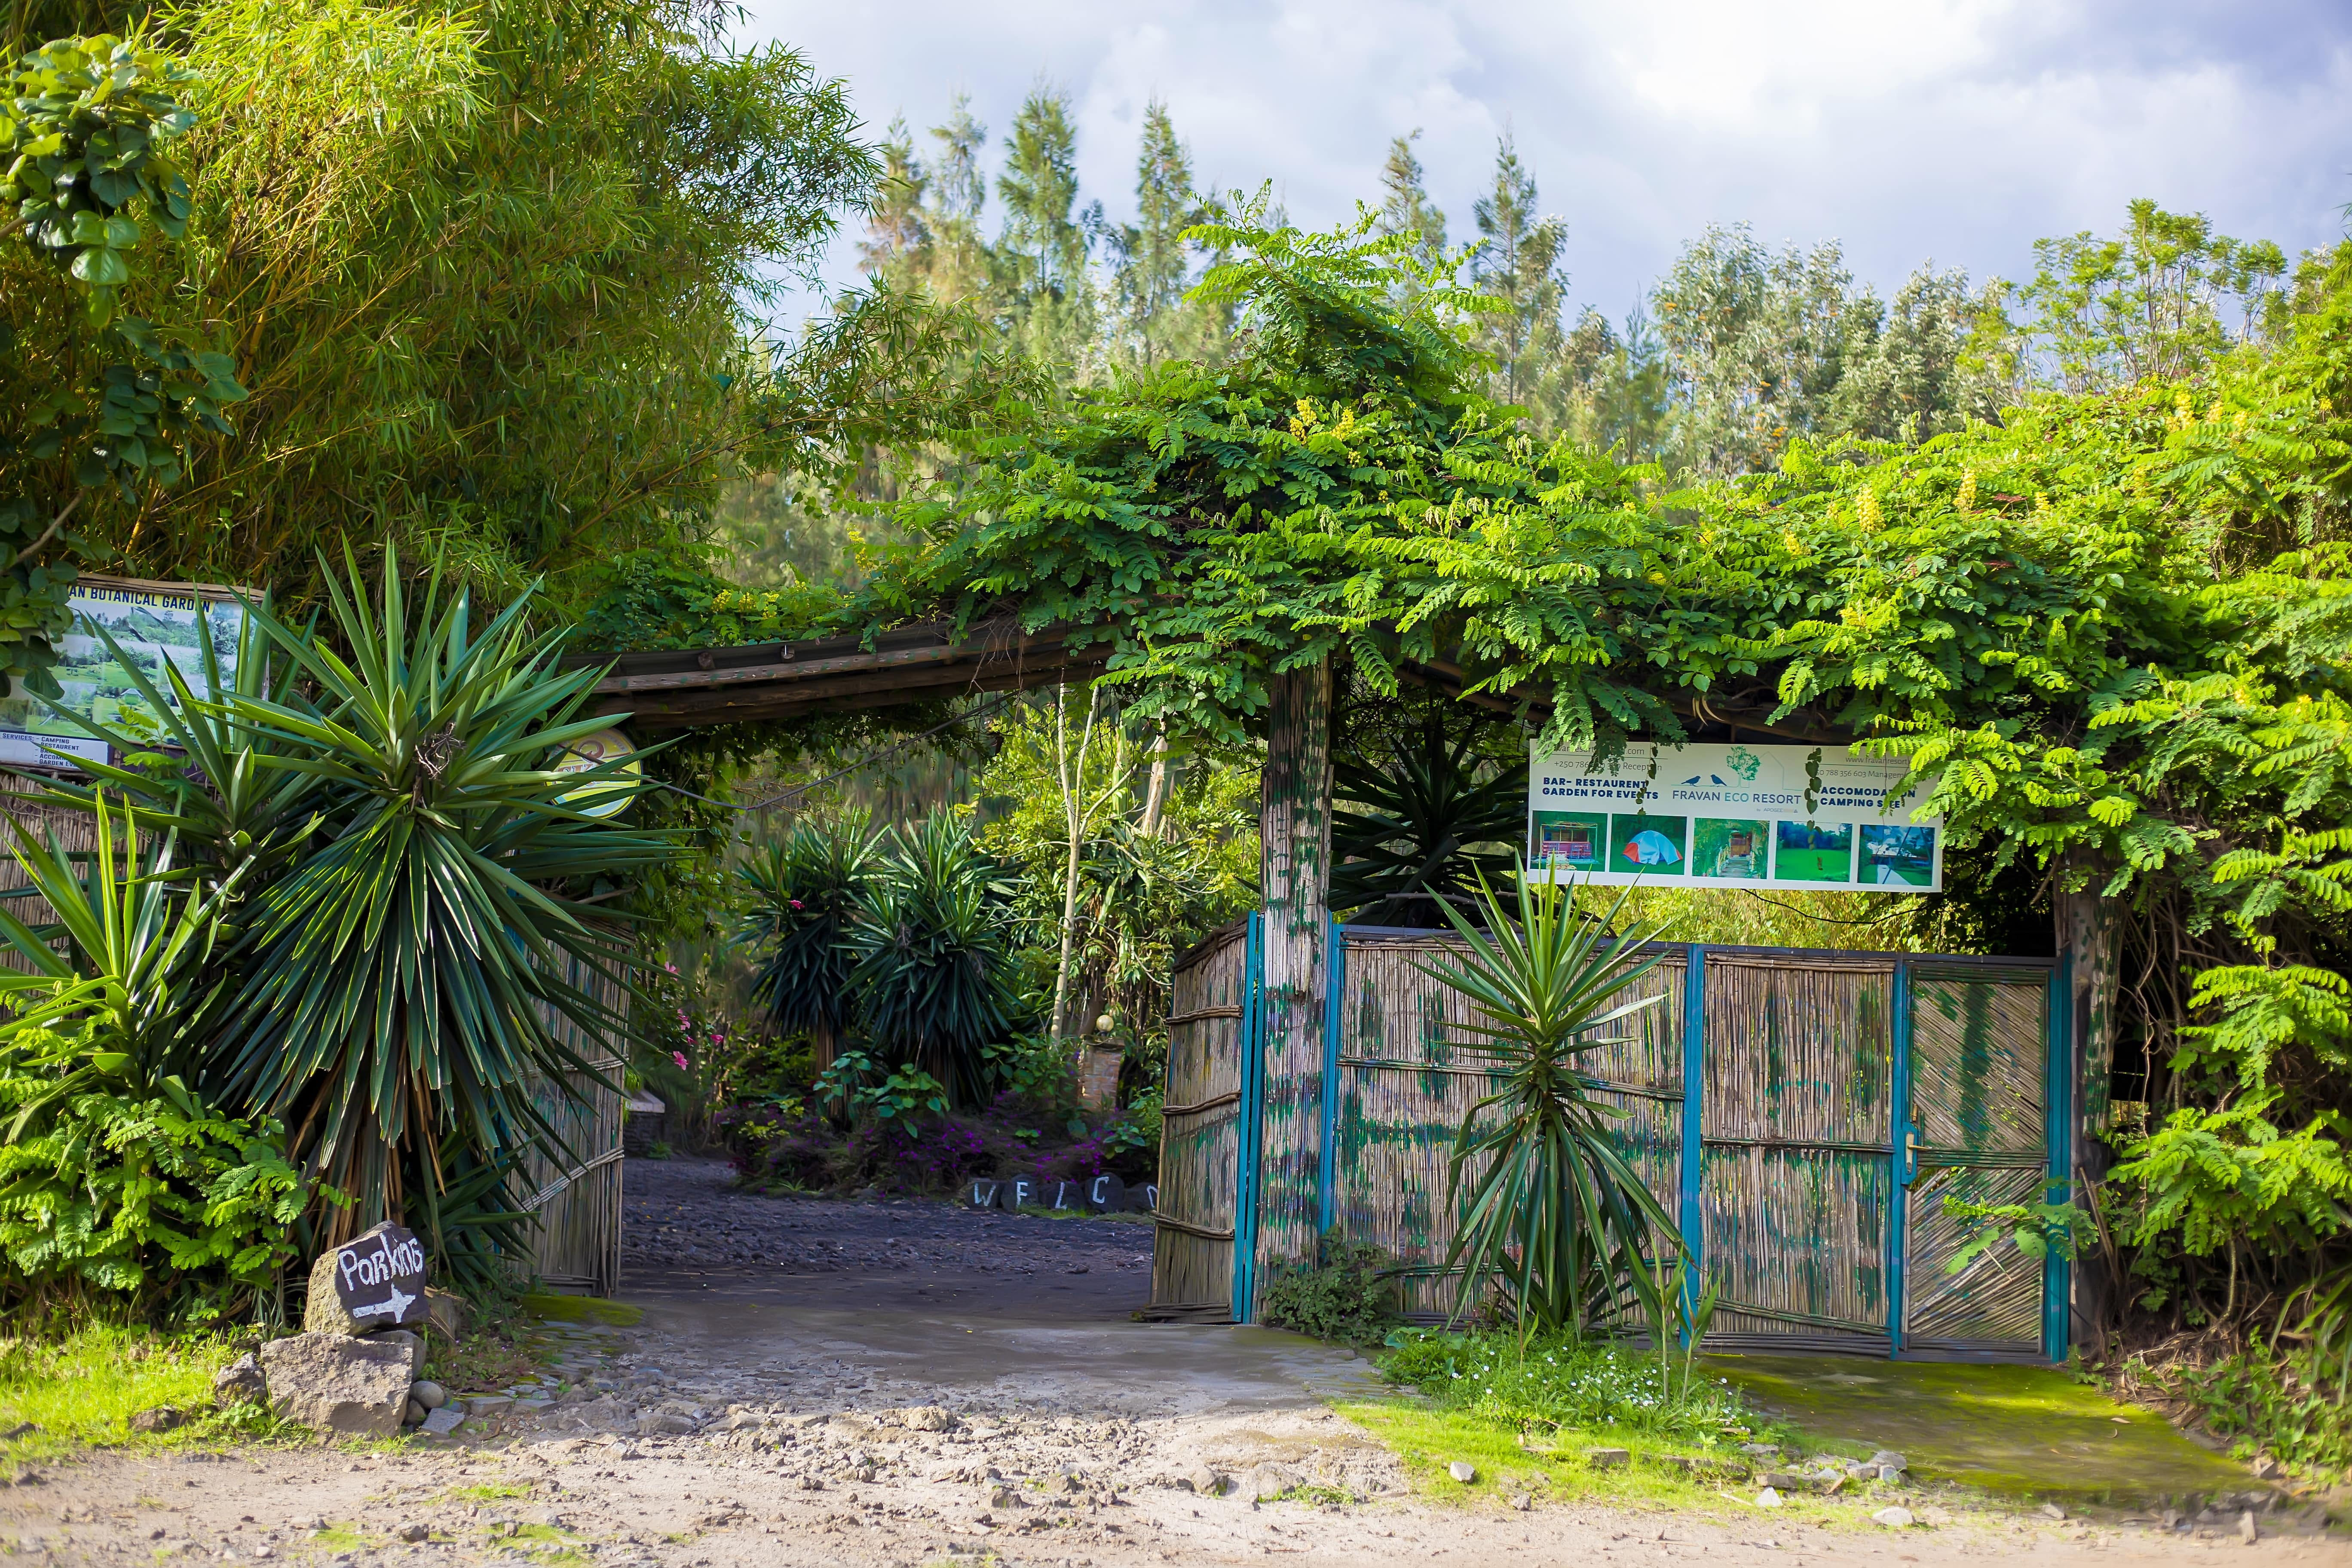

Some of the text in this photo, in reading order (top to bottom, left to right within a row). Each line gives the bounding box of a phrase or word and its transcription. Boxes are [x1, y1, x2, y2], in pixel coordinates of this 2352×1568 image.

[90, 587, 157, 606] BOTANICAL
[1623, 762, 1662, 772] Receptn
[1868, 771, 1907, 780] Managem
[1543, 777, 1647, 788] BAR- RESTAURENT
[1542, 787, 1588, 796] GARDEN
[1591, 789, 1613, 798] FOR
[1672, 790, 1802, 804] FRAVAN ECO RESORT
[1820, 797, 1874, 807] CAMPING
